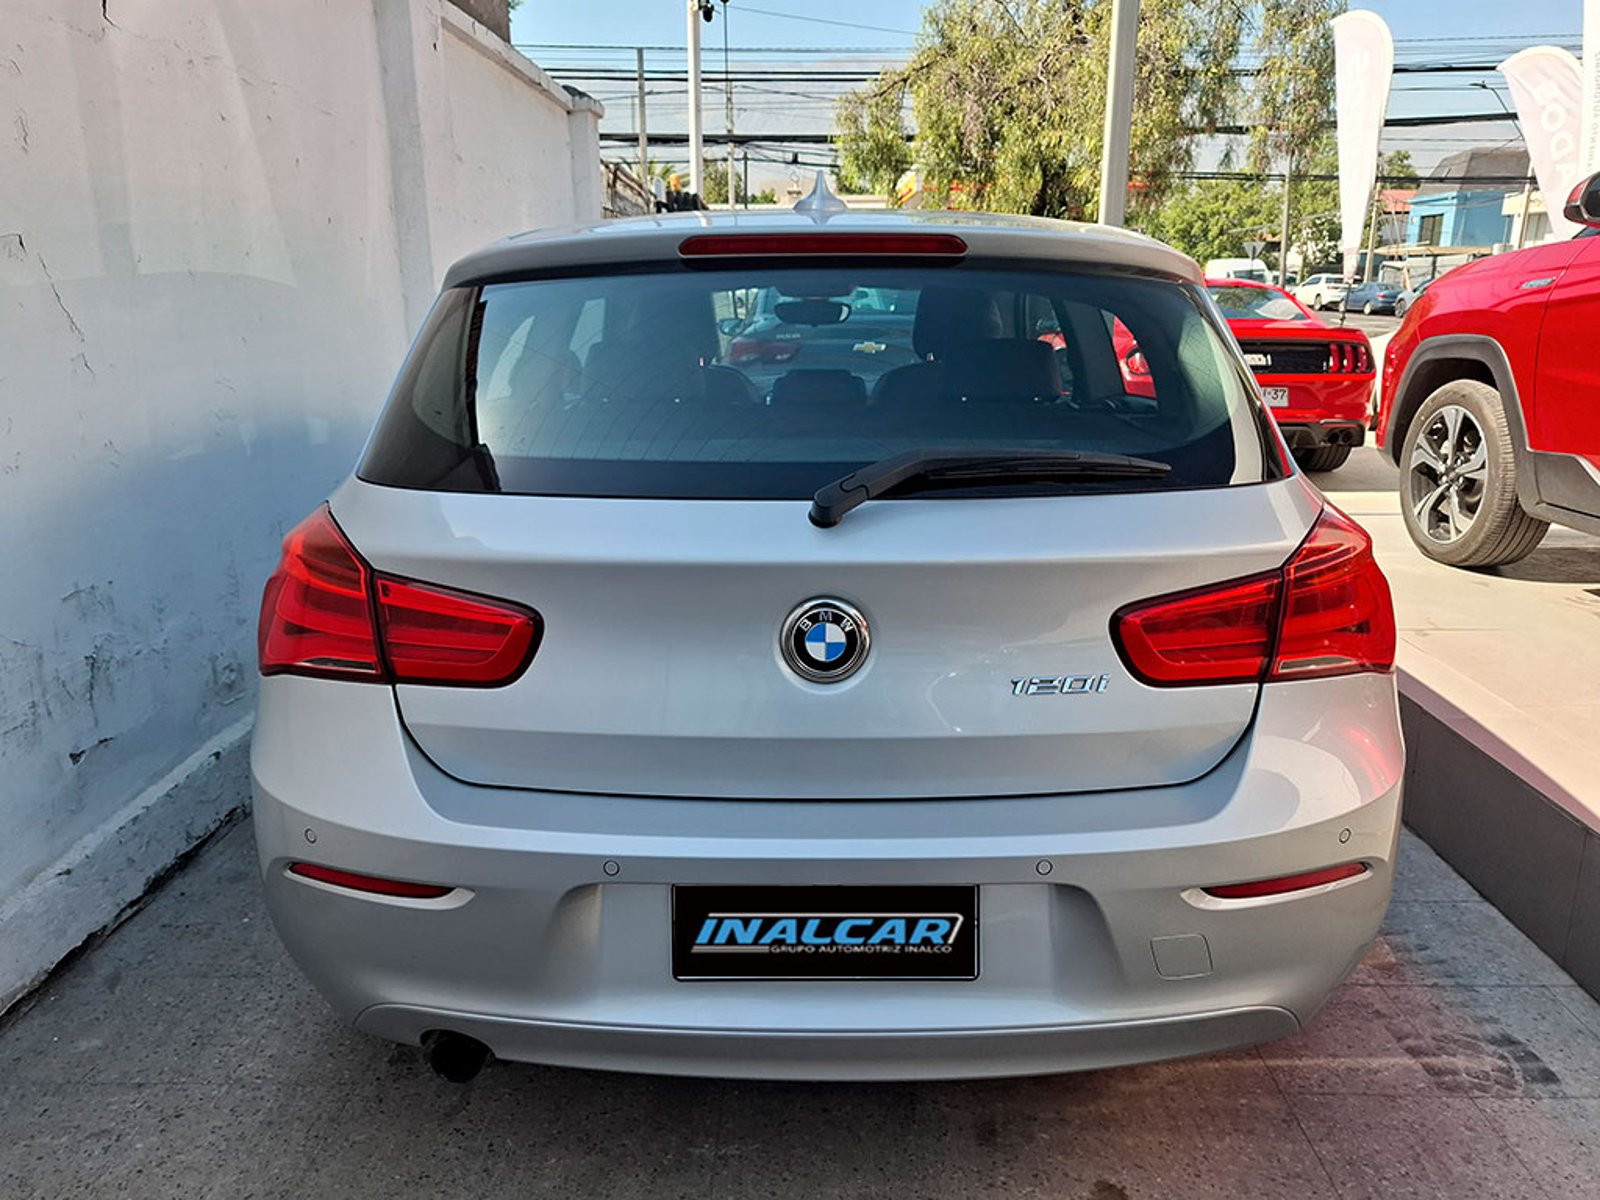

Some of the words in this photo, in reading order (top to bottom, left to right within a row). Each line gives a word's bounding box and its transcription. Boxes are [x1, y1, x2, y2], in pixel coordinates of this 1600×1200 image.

[800, 611, 854, 632] BMW
[1011, 674, 1110, 694] 120i
[695, 918, 952, 944] INALCAR
[770, 945, 815, 953] GRUPO
[818, 945, 900, 953] AUTOMOTRIZ
[904, 945, 952, 953] INALCO
